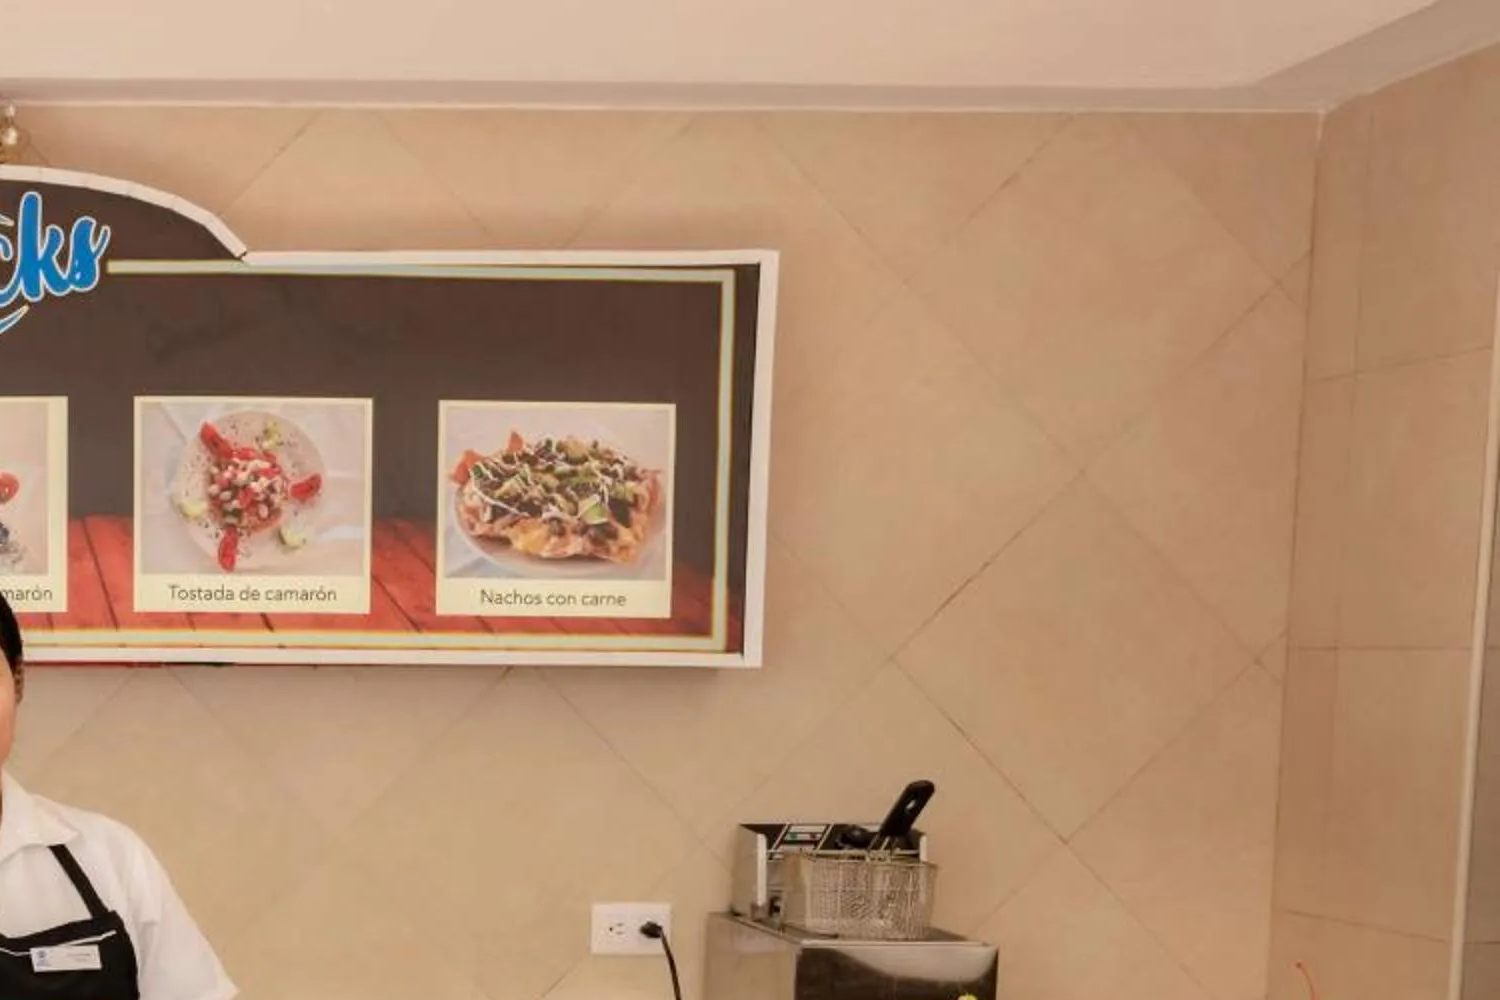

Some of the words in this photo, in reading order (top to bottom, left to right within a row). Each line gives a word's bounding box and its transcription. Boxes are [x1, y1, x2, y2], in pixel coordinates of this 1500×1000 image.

[1, 584, 53, 601] marón
[168, 584, 235, 602] Tostada
[239, 585, 260, 602] de
[264, 585, 337, 602] camarón
[479, 588, 542, 606] Nachos
[546, 594, 577, 606] con
[581, 594, 628, 607] carne
